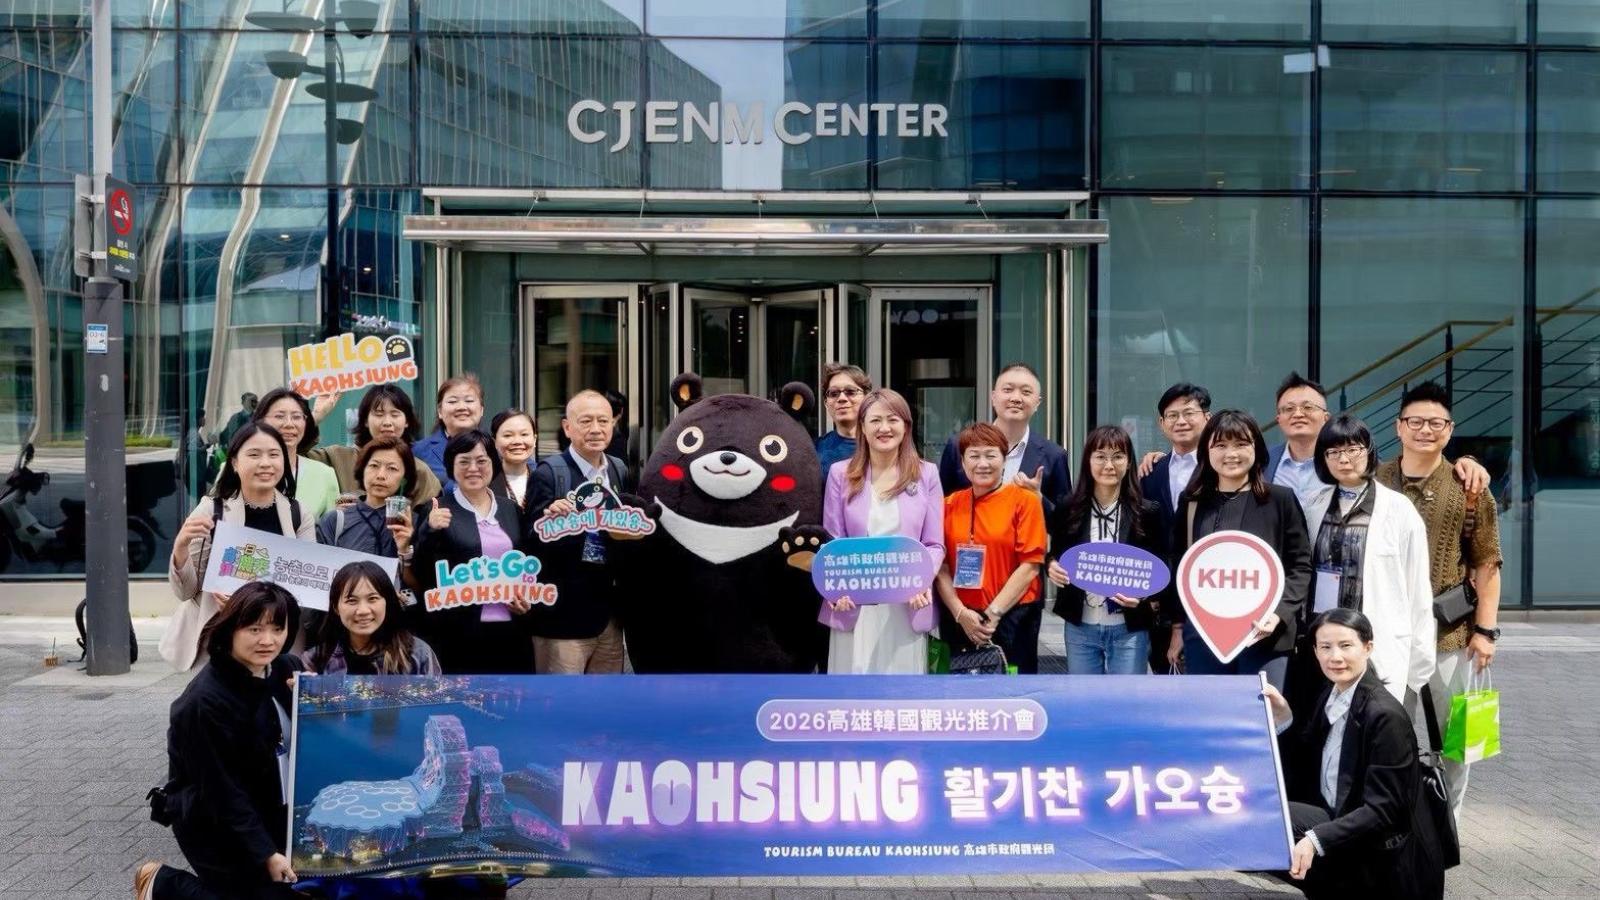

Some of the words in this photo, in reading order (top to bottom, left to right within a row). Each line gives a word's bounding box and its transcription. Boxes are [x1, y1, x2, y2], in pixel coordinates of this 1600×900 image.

[774, 101, 949, 145] CENTER
[290, 335, 381, 378] HELLO
[291, 361, 417, 397] KAOHSIUNG
[438, 558, 500, 587] Let's
[502, 552, 540, 578] Go
[522, 574, 534, 584] to
[824, 568, 862, 577] TOURISM
[864, 566, 900, 576] BUREAU
[1075, 570, 1150, 591] KAOHSIUNG
[1077, 562, 1115, 573] TOURISM
[1117, 568, 1152, 579] BUREAU
[1198, 567, 1260, 590] KHH
[428, 583, 556, 608] KAOHSIUNG
[824, 575, 923, 592] KAOHSIUNG
[769, 707, 1036, 733] 2026高雄韓國觀光推介會
[561, 759, 920, 827] KAOHSIUNG
[943, 766, 1084, 819] 활기찬
[1104, 765, 1246, 817] 가오슝
[764, 846, 823, 858] TOURISM
[827, 845, 881, 857] BUREAU
[886, 845, 960, 857] KAOHSIUNG
